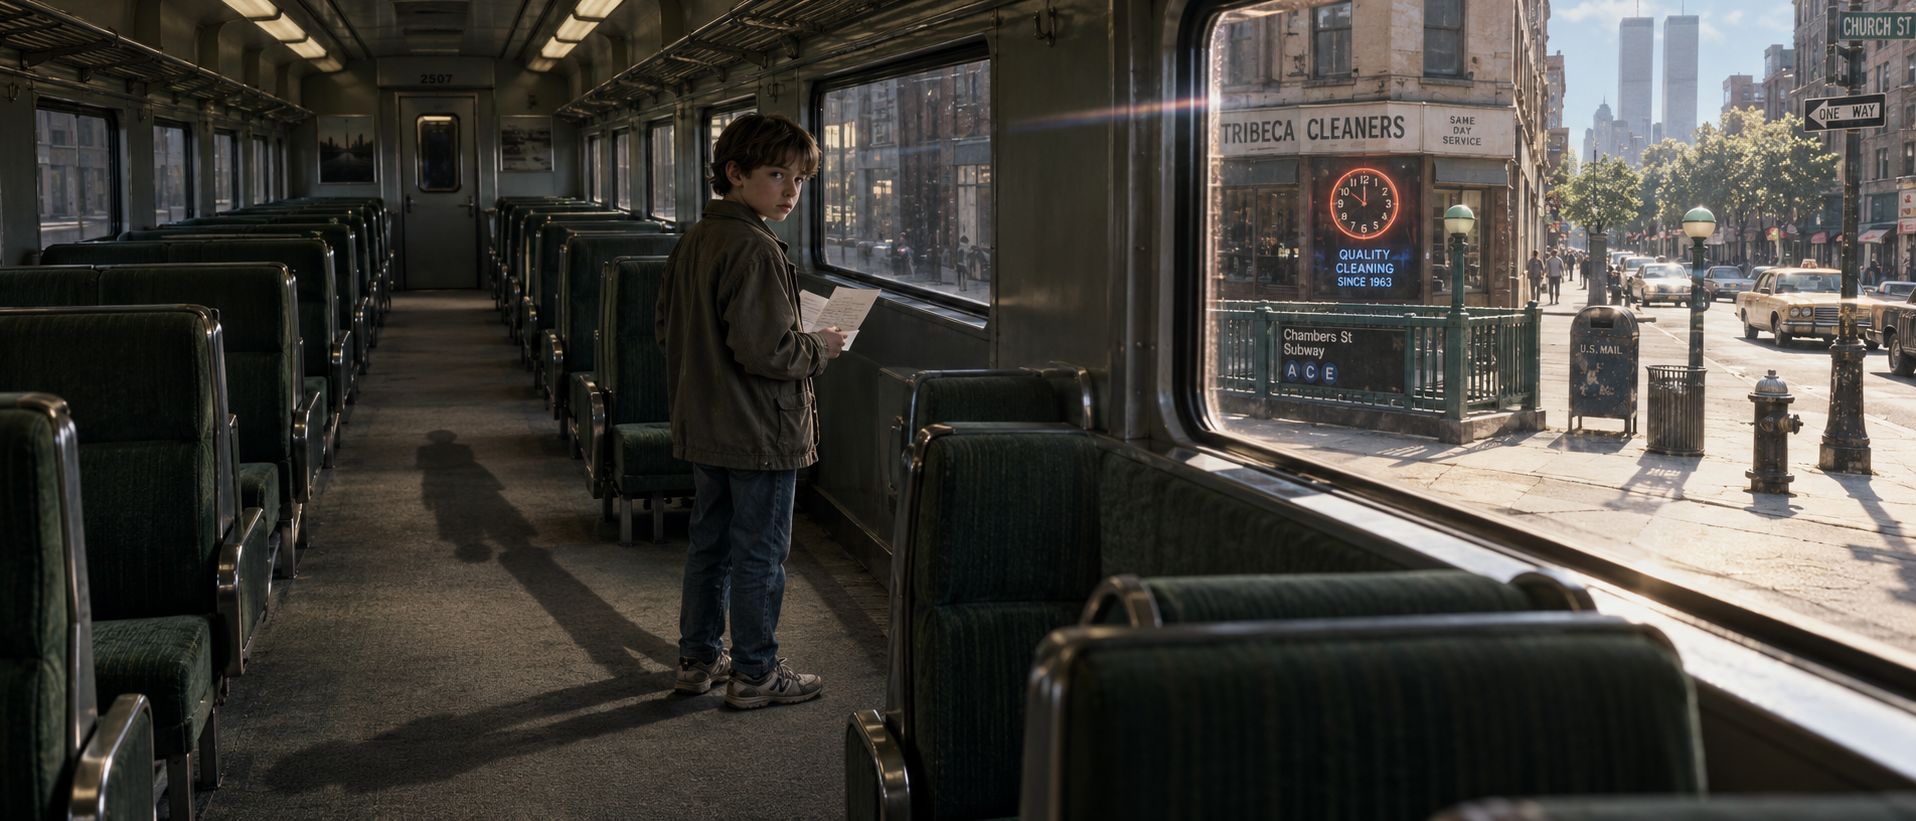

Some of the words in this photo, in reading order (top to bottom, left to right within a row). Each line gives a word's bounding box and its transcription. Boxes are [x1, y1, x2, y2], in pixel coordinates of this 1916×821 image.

[1843, 16, 1891, 36] CHURCH
[1897, 16, 1912, 36] ST
[420, 73, 453, 84] 2507
[1819, 107, 1840, 120] ONE
[1852, 104, 1876, 119] WAY
[1450, 115, 1476, 125] SAME
[1221, 119, 1295, 144] TRIBECA
[1307, 115, 1405, 140] CLEANERS
[1453, 126, 1472, 135] DAY
[1442, 136, 1482, 146] SERVICE
[1350, 178, 1357, 187] 11
[1360, 175, 1370, 184] 12
[1374, 178, 1378, 187] 1
[1340, 187, 1350, 196] 10
[1382, 187, 1388, 196] 2
[1337, 199, 1344, 208] 9
[1385, 199, 1392, 208] 3
[1341, 212, 1348, 221] 8
[1350, 221, 1356, 231] 7
[1360, 224, 1368, 233] 6
[1373, 221, 1379, 230] 5
[1339, 249, 1390, 260] QUALITY
[1335, 263, 1394, 274] CLEANING
[1337, 276, 1366, 287] SINCE
[1369, 277, 1392, 287] 1963
[1283, 328, 1337, 343] Chambers
[1340, 330, 1353, 343] St
[1283, 342, 1325, 359] Subway
[1580, 344, 1599, 354] U.S.
[1600, 345, 1623, 355] MAIL
[1287, 364, 1297, 377] A
[1306, 365, 1315, 379] C
[1325, 366, 1334, 380] E
